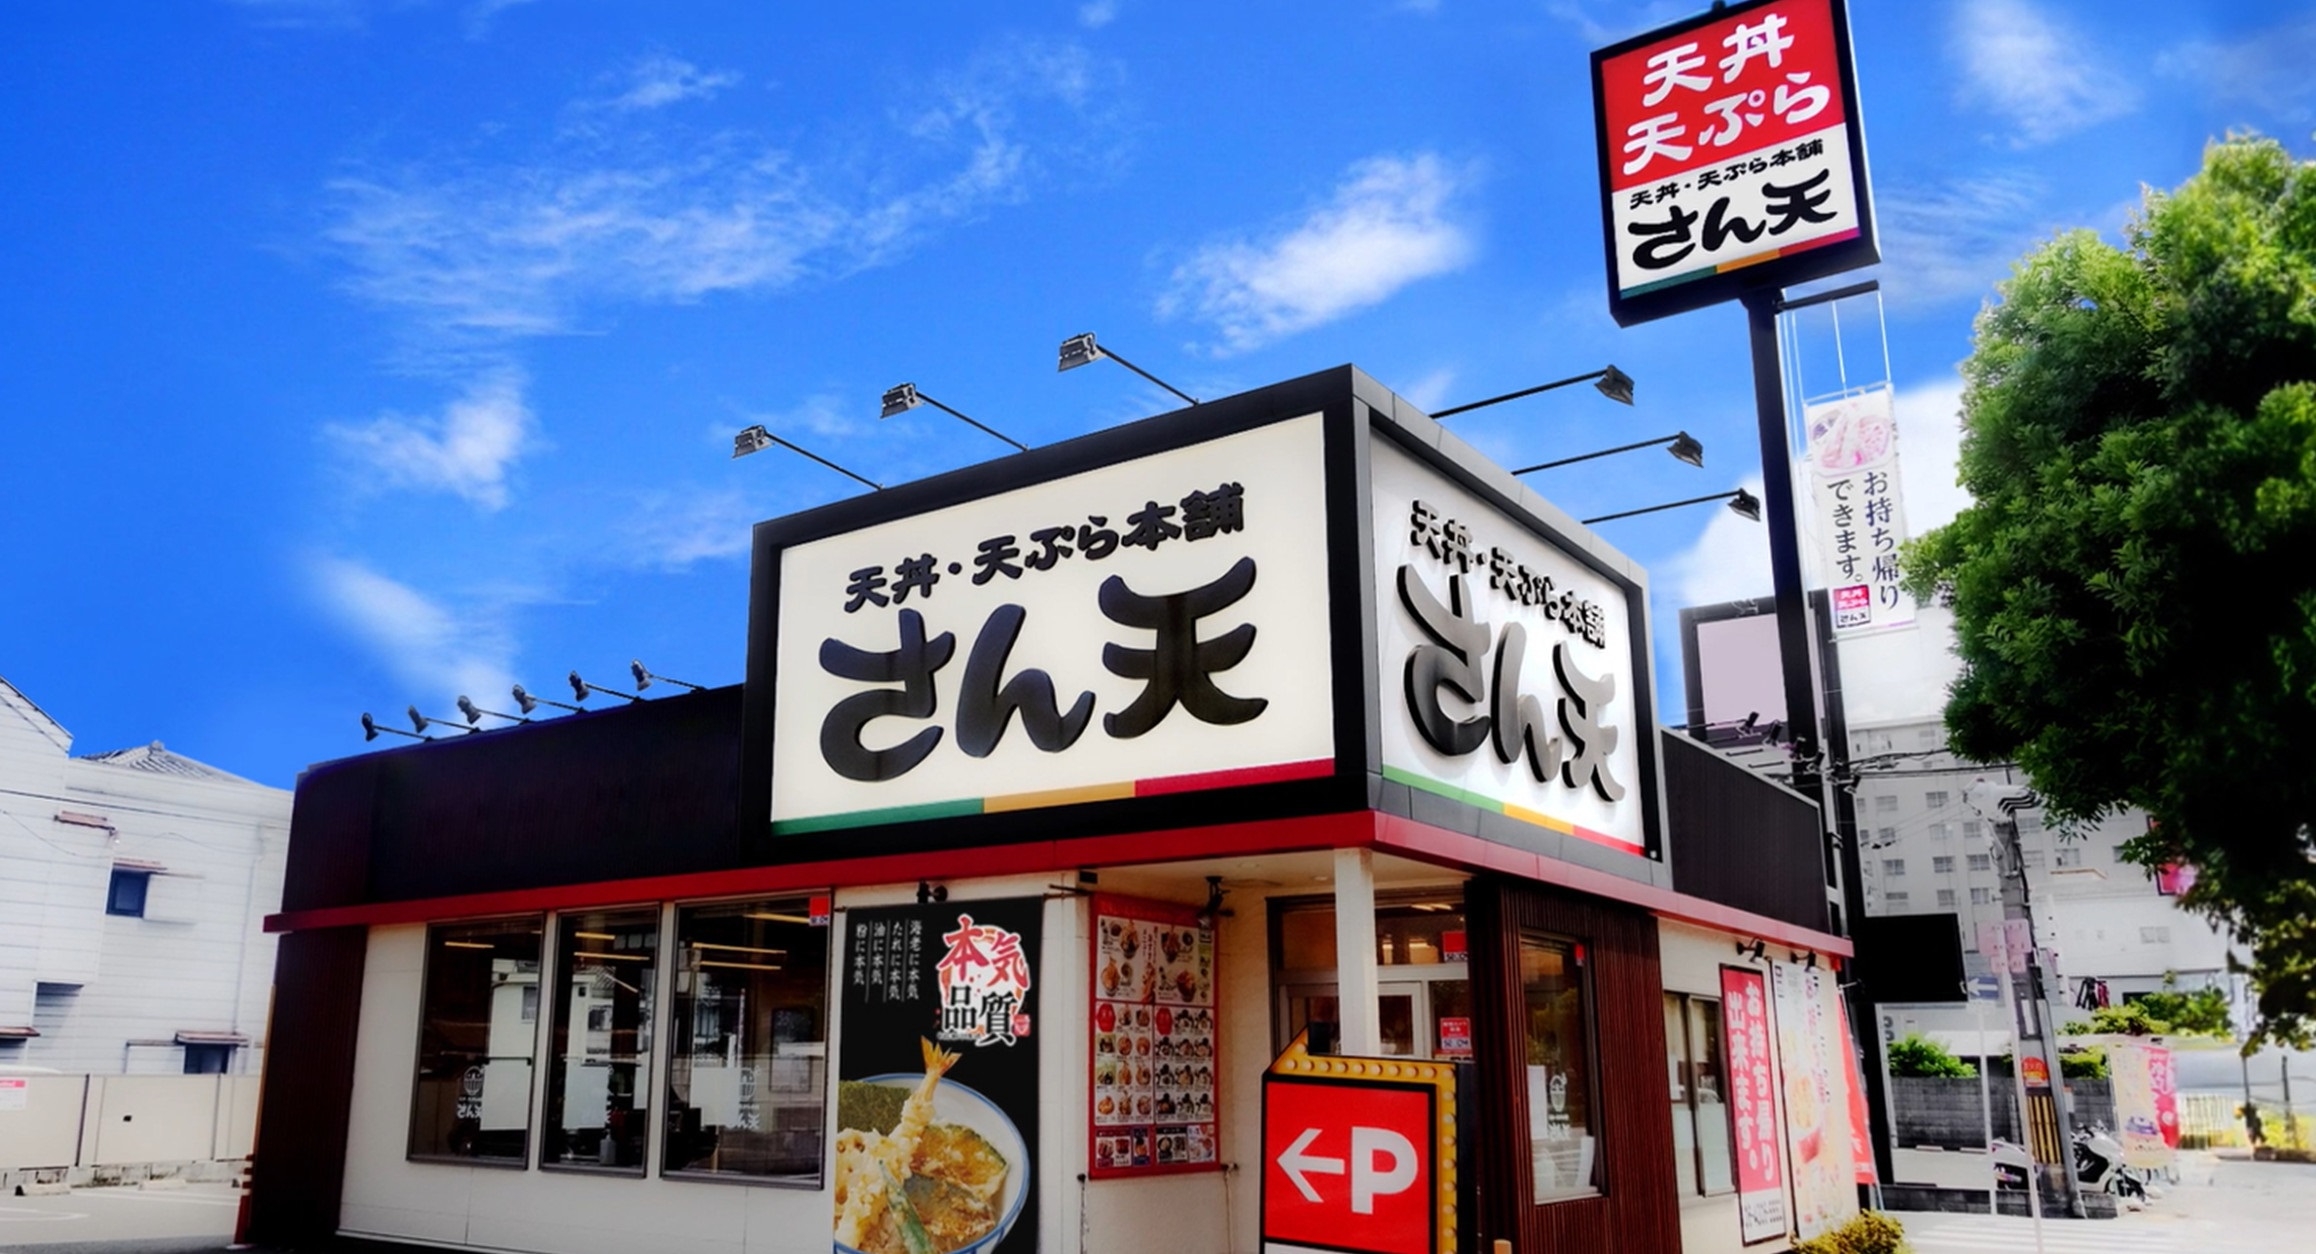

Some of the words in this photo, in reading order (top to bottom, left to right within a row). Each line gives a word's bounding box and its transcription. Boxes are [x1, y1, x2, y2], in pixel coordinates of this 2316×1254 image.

[1642, 13, 1794, 107] 天丼
[1623, 71, 1831, 175] 天ぷら
[1629, 139, 1824, 210] 天丼・天ぷら本舗
[1627, 168, 1838, 270] さん天
[844, 482, 1244, 613] 天丼・天ぷら本舗
[1827, 478, 1864, 583] できます。
[1864, 471, 1900, 610] お持ち帰り
[818, 555, 1269, 782] さん天
[1396, 563, 1626, 802] さん天
[936, 914, 1031, 991] 本気
[944, 985, 1017, 1046] 品質
[1351, 1126, 1418, 1214] P
